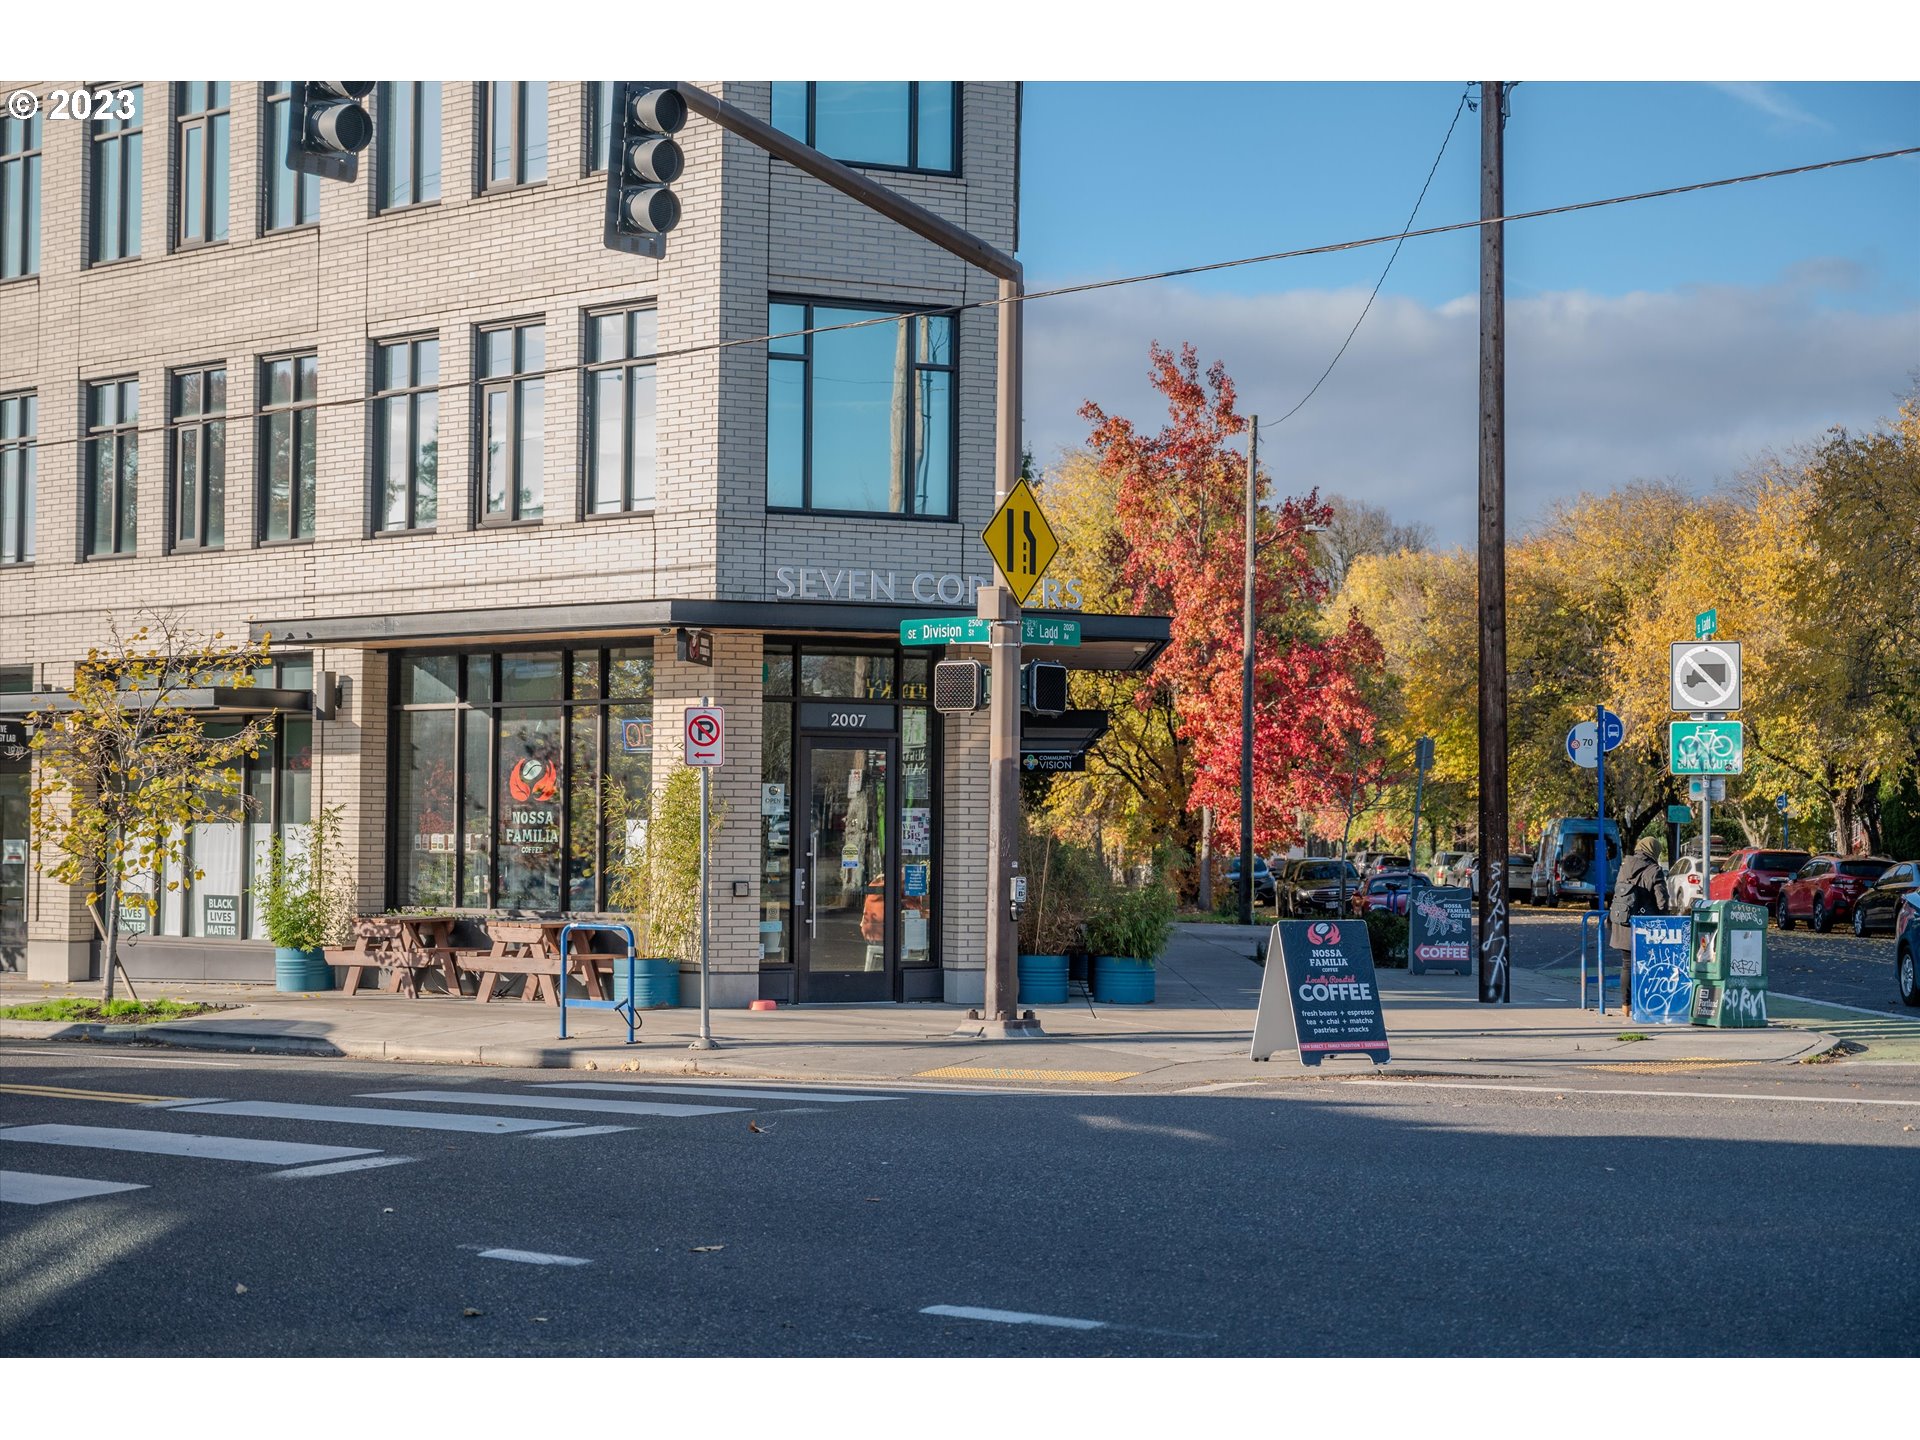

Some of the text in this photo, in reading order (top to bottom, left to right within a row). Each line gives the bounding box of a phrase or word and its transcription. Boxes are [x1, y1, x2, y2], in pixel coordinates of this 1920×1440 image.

[776, 567, 1083, 609] SEVEN CORRS
[968, 619, 983, 628] 2500
[908, 630, 917, 640] SE
[923, 624, 962, 639] Division
[1026, 627, 1034, 637] SE
[1039, 626, 1059, 639] Ladd
[831, 713, 867, 727] 2007
[1582, 738, 1593, 747] 70
[1039, 761, 1072, 769] VISION
[512, 811, 553, 825] NOSSA
[506, 828, 559, 843] FAMILIA
[903, 830, 921, 843] Big
[521, 846, 543, 854] COFFEE
[208, 898, 233, 909] BLACK
[210, 912, 232, 922] LIVES
[207, 925, 236, 936] MATTER
[1312, 949, 1342, 957] NOSSA
[1420, 947, 1468, 958] COFFEE
[1309, 959, 1348, 967] FAMILIA
[1298, 983, 1372, 1001] COFFEE
[1313, 1027, 1338, 1035] pastries
